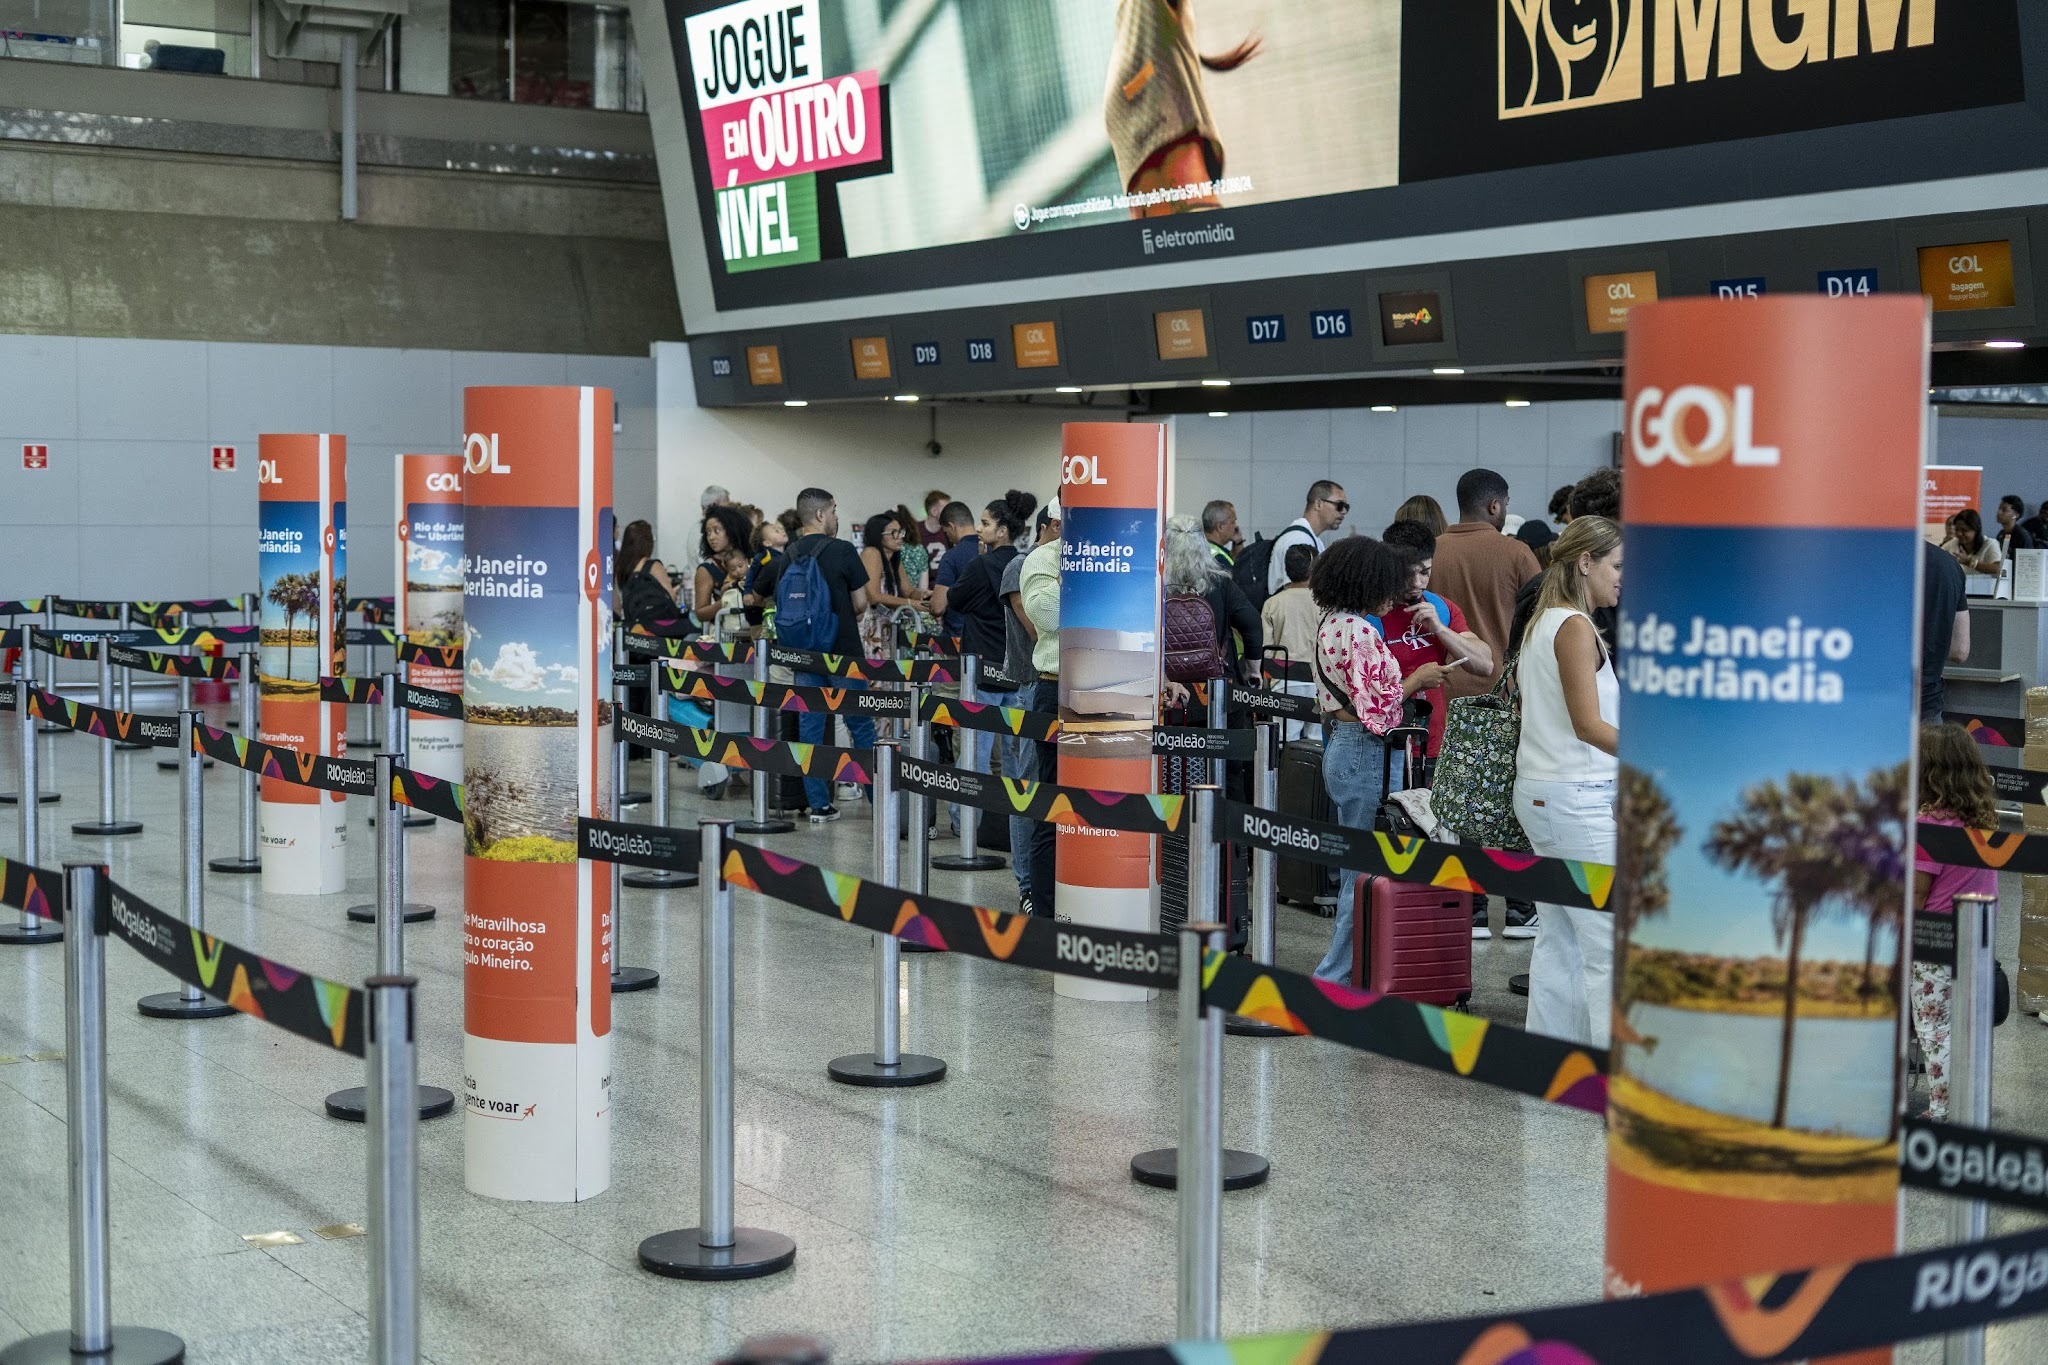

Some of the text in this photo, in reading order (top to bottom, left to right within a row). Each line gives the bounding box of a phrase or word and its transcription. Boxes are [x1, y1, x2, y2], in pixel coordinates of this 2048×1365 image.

[704, 5, 809, 99] JOGUE
[723, 76, 866, 172] EM OUTRO
[1155, 224, 1235, 249] eletromidia
[1949, 256, 1983, 273] GOL
[1608, 283, 1635, 300] GOL
[1827, 276, 1870, 299] D14
[1252, 320, 1279, 340] D17
[1315, 315, 1346, 335] D16
[916, 346, 938, 363] D19
[970, 343, 993, 360] D18
[1630, 385, 1781, 467] GOL
[1061, 455, 1108, 485] GOL
[426, 472, 463, 493] GOL
[262, 527, 304, 541] Janeiro
[414, 521, 431, 532] Rio
[433, 522, 446, 532] de
[1063, 541, 1134, 557] de Janeiro
[474, 554, 548, 577] Janeiro
[1061, 557, 1131, 573] Uberlândia
[464, 577, 544, 599] berlândia
[1638, 613, 1677, 654] de
[1683, 616, 1853, 661] Janeiro
[770, 648, 802, 664] RIOgaleão
[1627, 656, 1844, 704] Uberlândia
[407, 689, 440, 709] RIOgaleão
[858, 695, 904, 711] RIOgaleão
[1233, 689, 1280, 709] RIOgaleão
[141, 721, 172, 740] RIOgaleão
[621, 715, 663, 741] RIOgaleão
[1153, 731, 1206, 751] IOgaleão
[327, 763, 366, 786] RIOgaleão
[901, 761, 960, 793] RIOgaleão
[270, 837, 287, 845] voar
[1077, 825, 1119, 837] Mineiro.
[1243, 813, 1320, 852] RIOgaleão
[588, 828, 652, 857] RIOgaleão
[112, 893, 158, 947] RIOgaleão
[471, 914, 546, 934] Maravilhosa
[474, 936, 480, 947] o
[482, 937, 534, 954] coração
[1056, 932, 1160, 974] RIOgaleão
[481, 953, 534, 971] Mineiro.
[488, 1100, 520, 1114] voar
